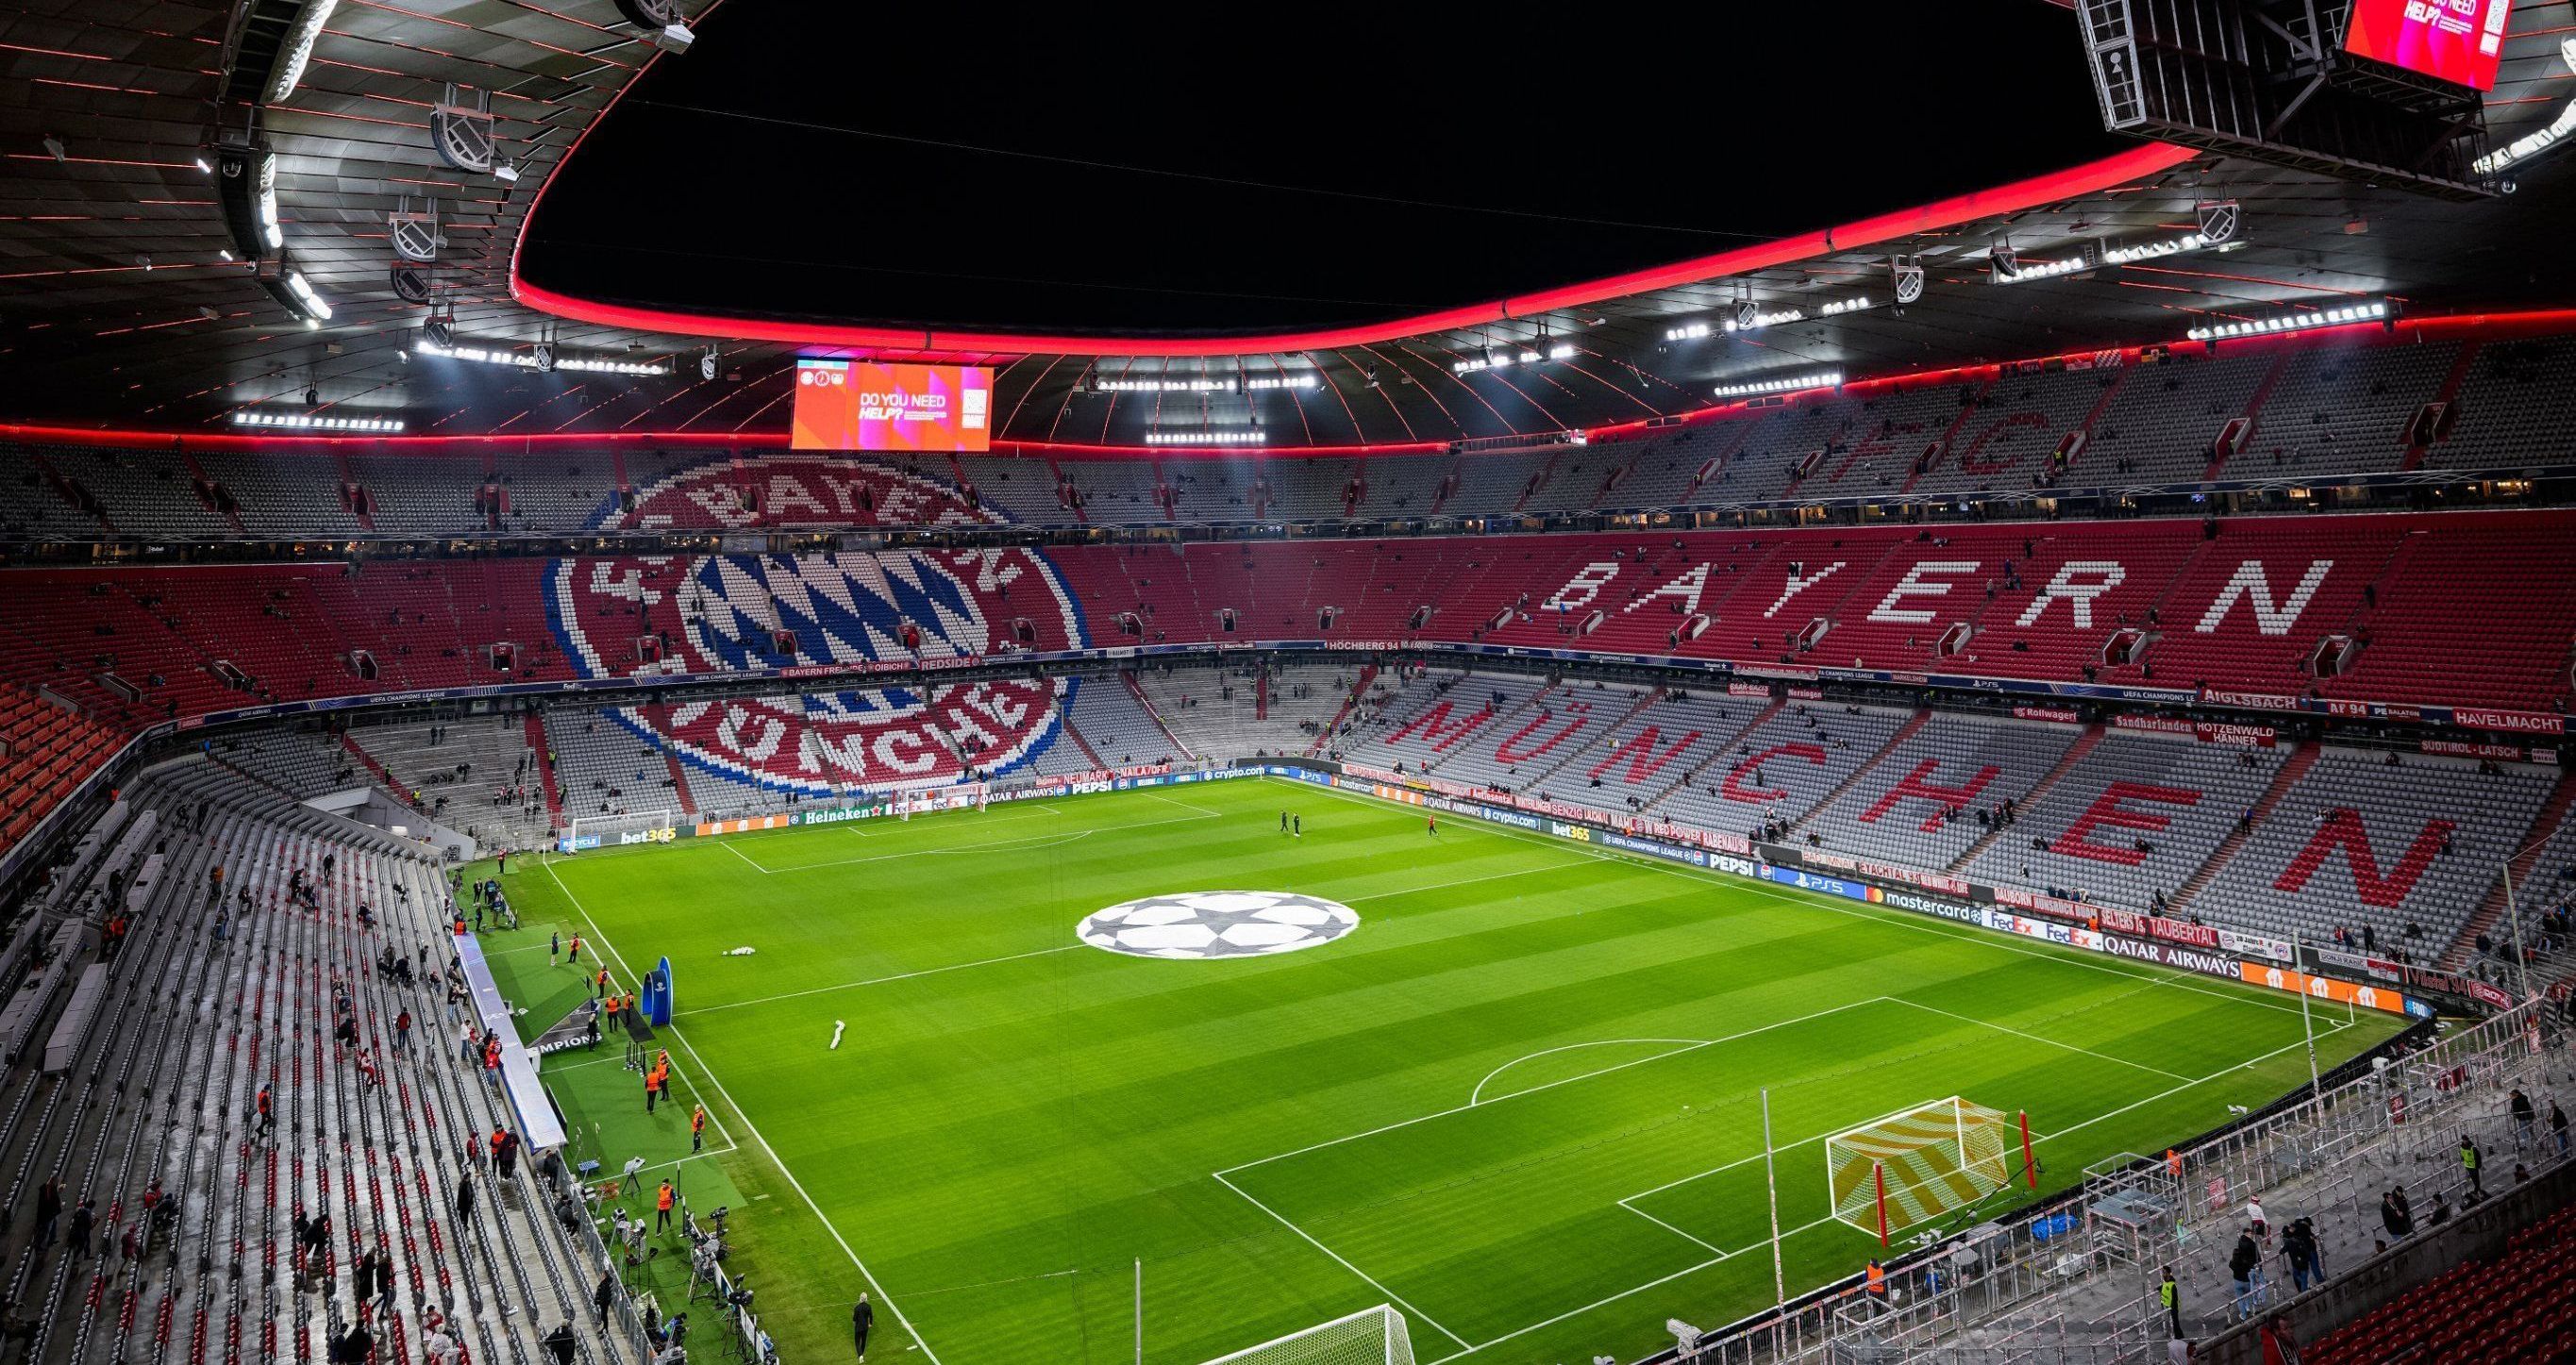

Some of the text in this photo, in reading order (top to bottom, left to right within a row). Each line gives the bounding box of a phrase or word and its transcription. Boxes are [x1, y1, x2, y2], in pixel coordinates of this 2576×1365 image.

[2403, 1, 2442, 26] HELP?
[861, 392, 945, 408] DO YOU NEED
[859, 407, 904, 420] HELP?
[1542, 560, 2333, 635] BAYERN
[789, 667, 822, 677] BAYERN
[921, 658, 970, 671] REDSIDE
[743, 671, 762, 679] LEAGUE
[370, 691, 445, 704] UEFA CHAMPIONS LEAGUE
[2123, 690, 2142, 698] UEFA
[2143, 691, 2184, 701] CHAMPIONS
[2205, 689, 2297, 709] AIGLSBACH
[2350, 703, 2367, 714] 94
[2116, 715, 2192, 733] Sandharlanden
[2197, 722, 2274, 738] HOTZENWALD
[2456, 712, 2563, 732] HAVELMACHT
[2213, 730, 2258, 746] HÄNNER
[2478, 743, 2518, 757] LATSCH
[1063, 770, 1108, 784] NEUMARK
[1214, 766, 1265, 780] crypto.com
[1072, 780, 1112, 794] PEPSI
[980, 787, 1055, 804] QATAR AIRWAYS
[1429, 797, 1481, 816] QATAR AIRWAYS
[1552, 804, 1583, 819] SENZIG
[806, 808, 870, 824] Heineken
[1493, 809, 1537, 828] crypto.com
[621, 828, 677, 844] bet365
[1552, 822, 1590, 841] bet365
[563, 837, 597, 847] RCYCLE
[1612, 835, 1683, 859] UEFA CHAMPIONS LEAGUE
[1710, 854, 1754, 877] PEPSI
[1811, 877, 1845, 893] PS5
[1994, 887, 2032, 907] DAUBORN
[1887, 891, 1970, 921] mastercard
[1991, 911, 2032, 935] FedEx
[2101, 908, 2133, 931] SELTERS
[2046, 923, 2091, 948] FedEx
[2149, 918, 2216, 946] TAUBERTAL
[2104, 936, 2241, 977] QATAR AIRWAYS
